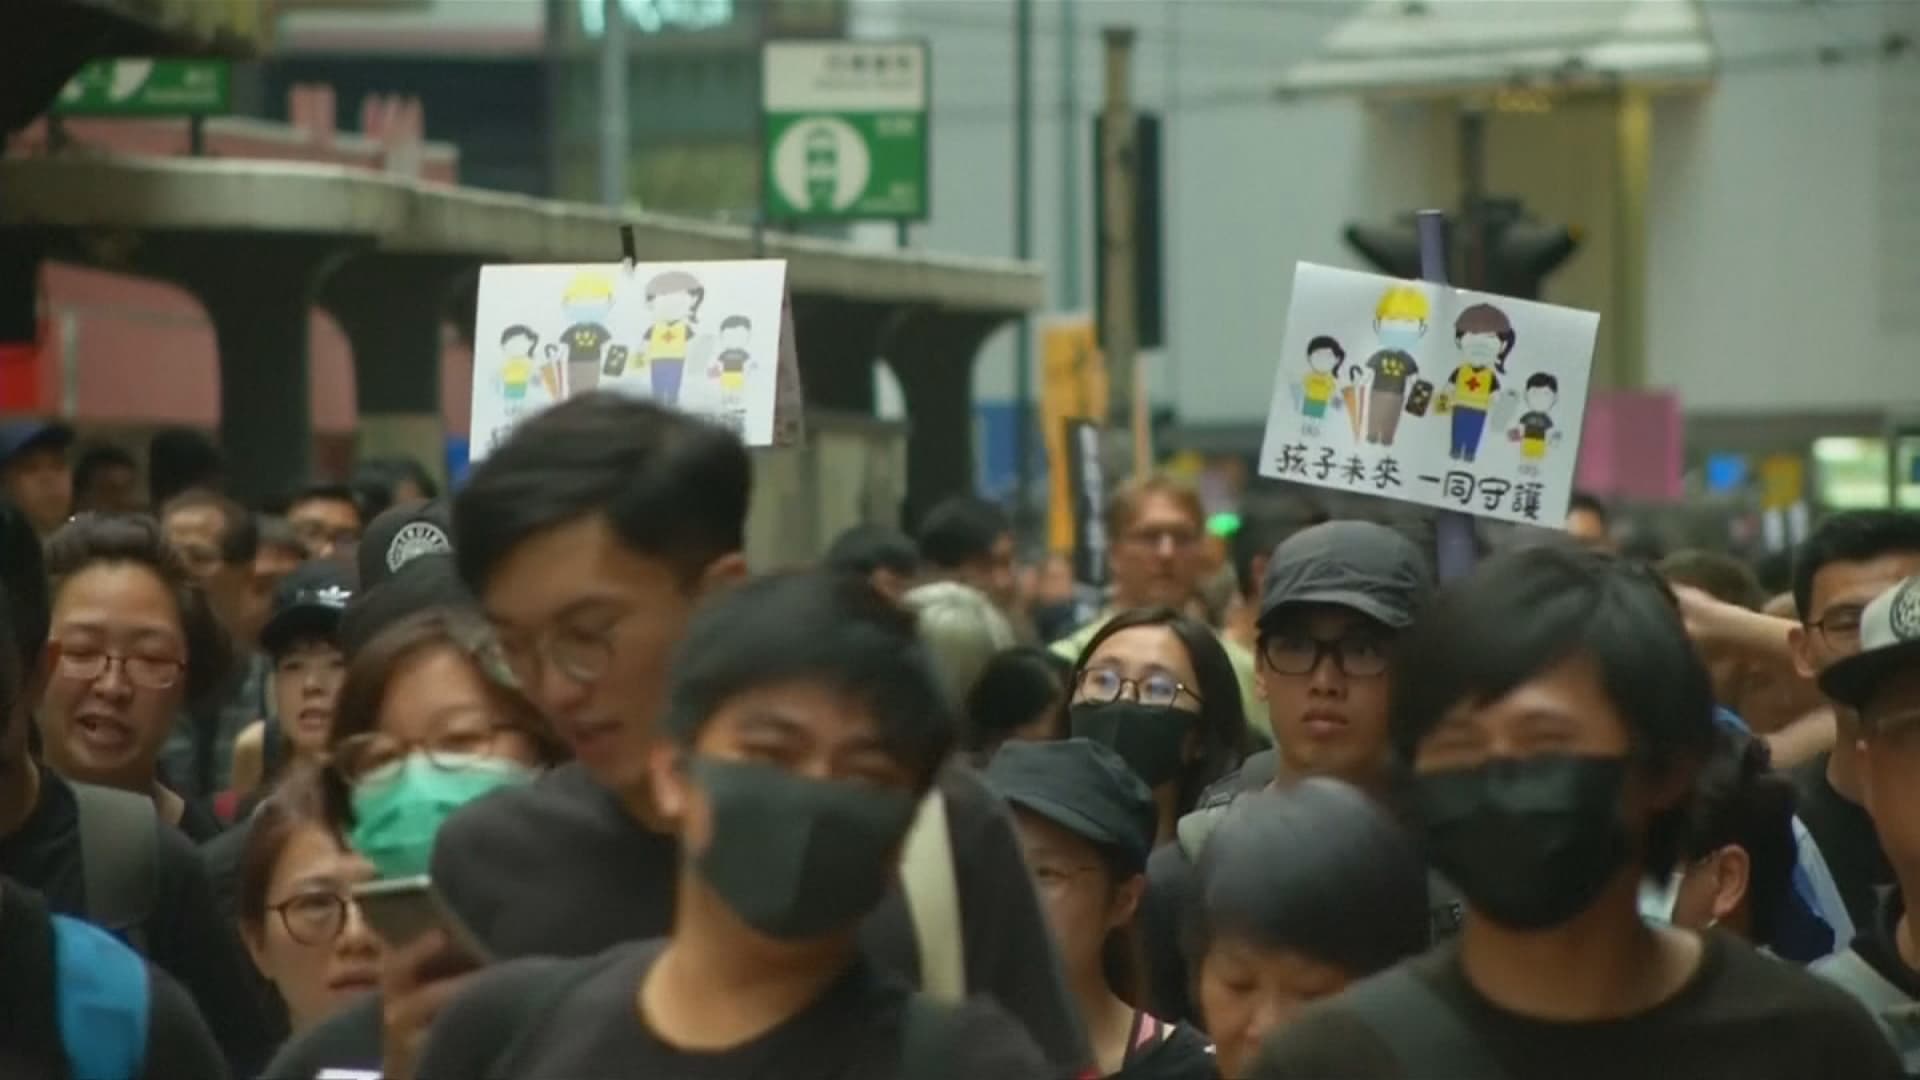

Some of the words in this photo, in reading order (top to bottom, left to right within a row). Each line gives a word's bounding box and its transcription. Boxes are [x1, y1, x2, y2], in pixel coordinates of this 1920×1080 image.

[1276, 443, 1402, 489] 孩子未來
[1418, 470, 1544, 520] 一同守護
